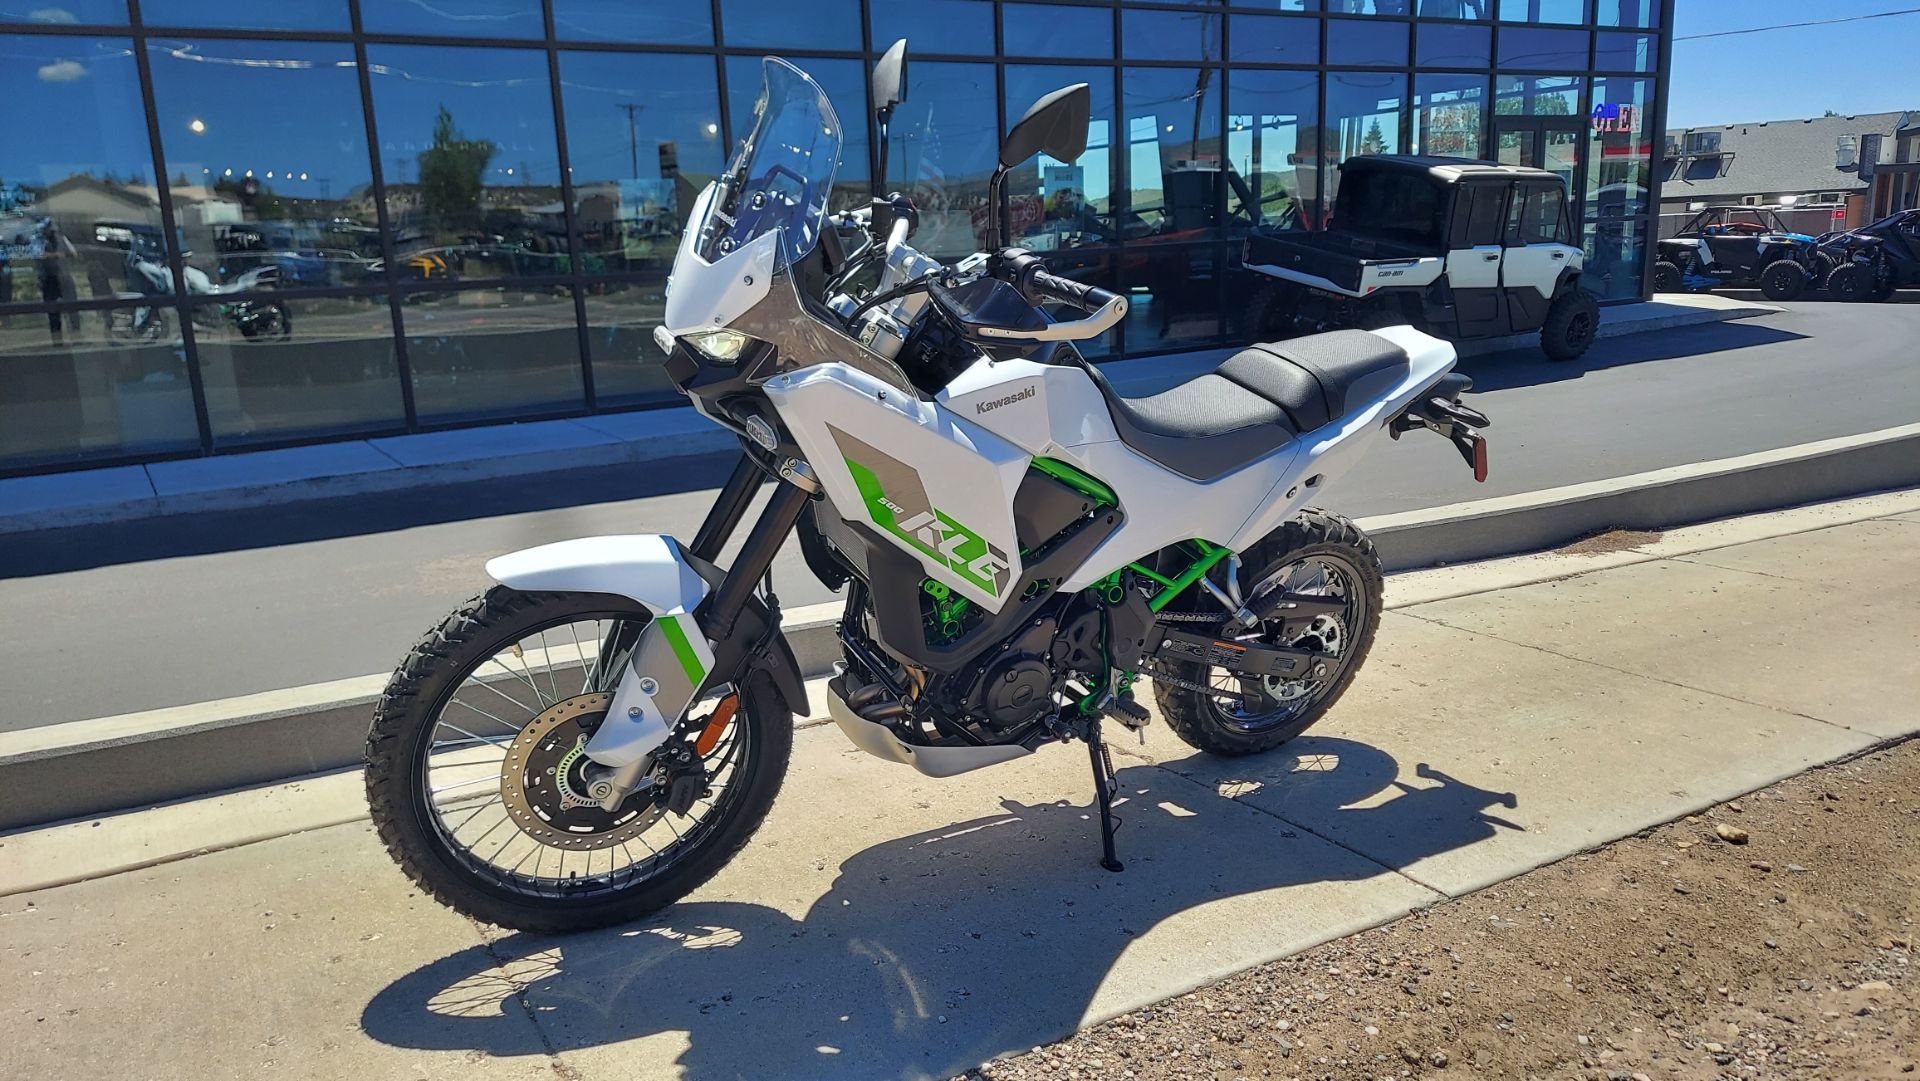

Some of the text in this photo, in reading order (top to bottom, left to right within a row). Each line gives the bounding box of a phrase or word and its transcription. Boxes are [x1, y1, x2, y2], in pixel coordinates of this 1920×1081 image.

[1593, 103, 1642, 132] OPEN
[976, 385, 1035, 414] Kawasaki
[877, 497, 904, 514] 500
[897, 510, 1010, 581] KLE
